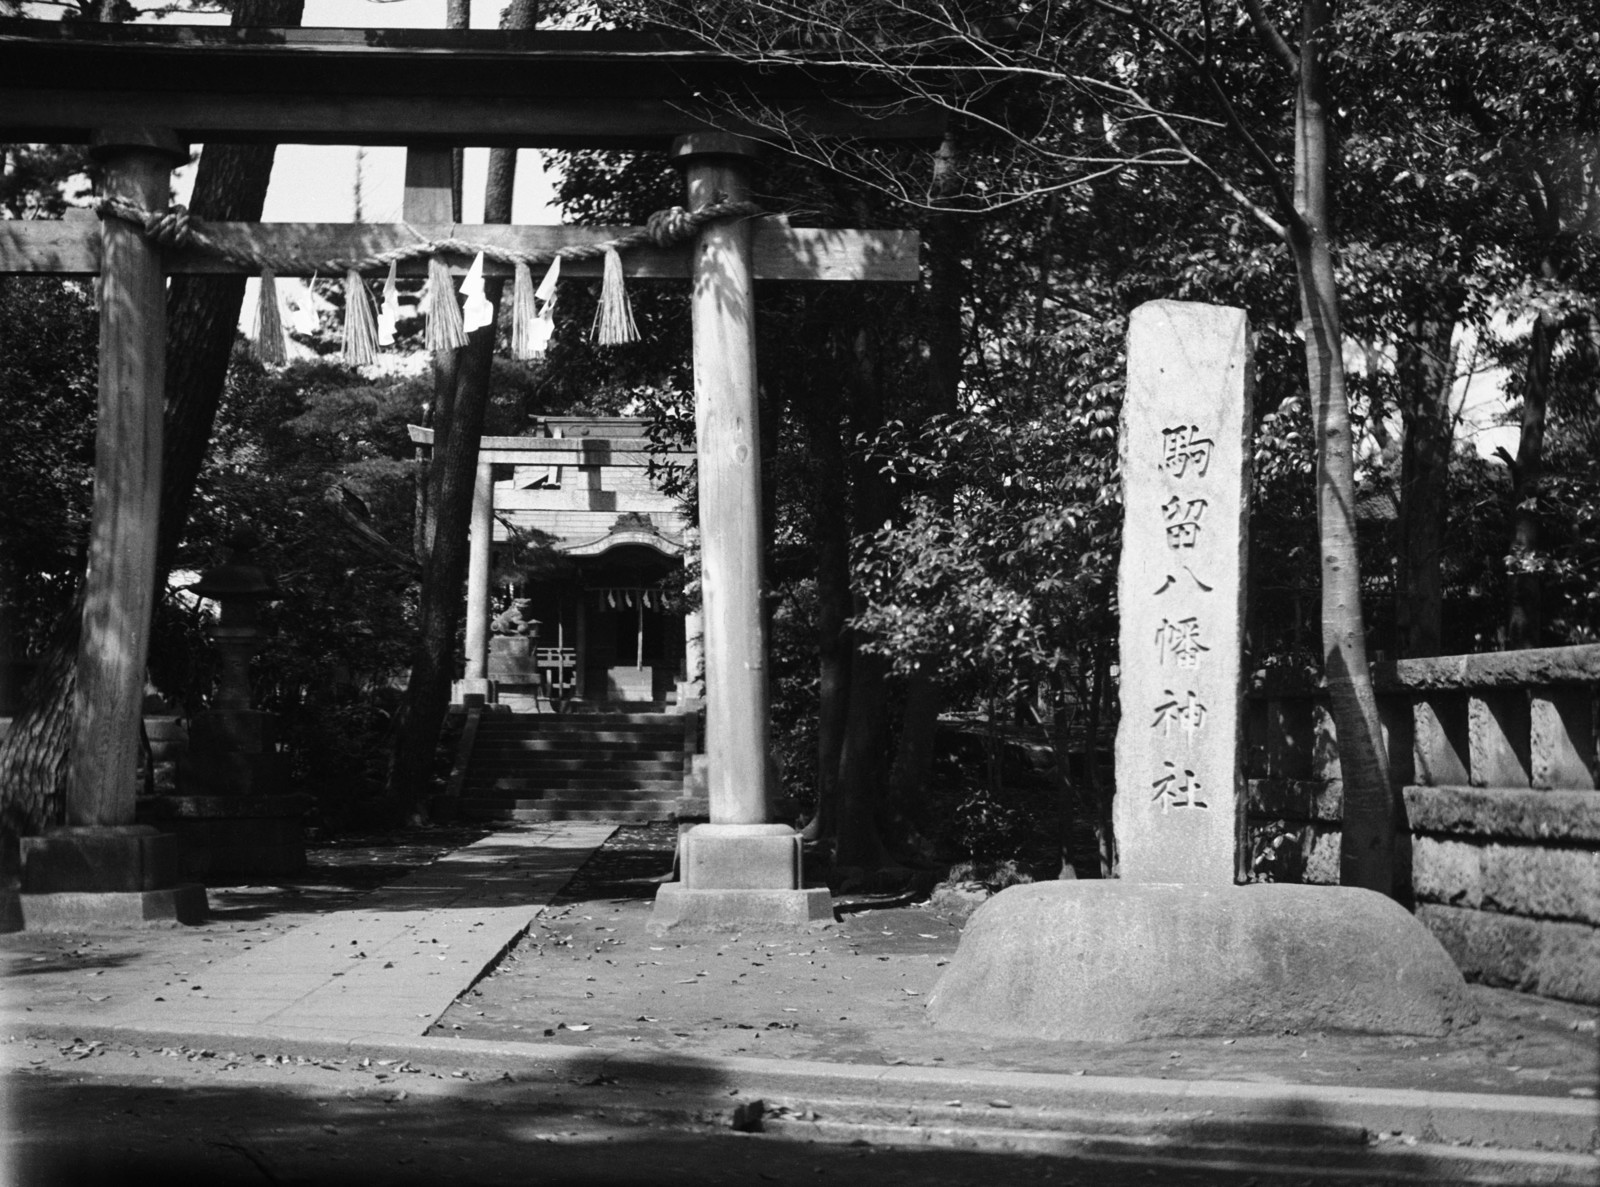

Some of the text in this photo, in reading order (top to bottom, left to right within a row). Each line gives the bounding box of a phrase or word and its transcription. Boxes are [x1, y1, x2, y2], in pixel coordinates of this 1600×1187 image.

[1152, 424, 1215, 813] 駒留八幡神社
